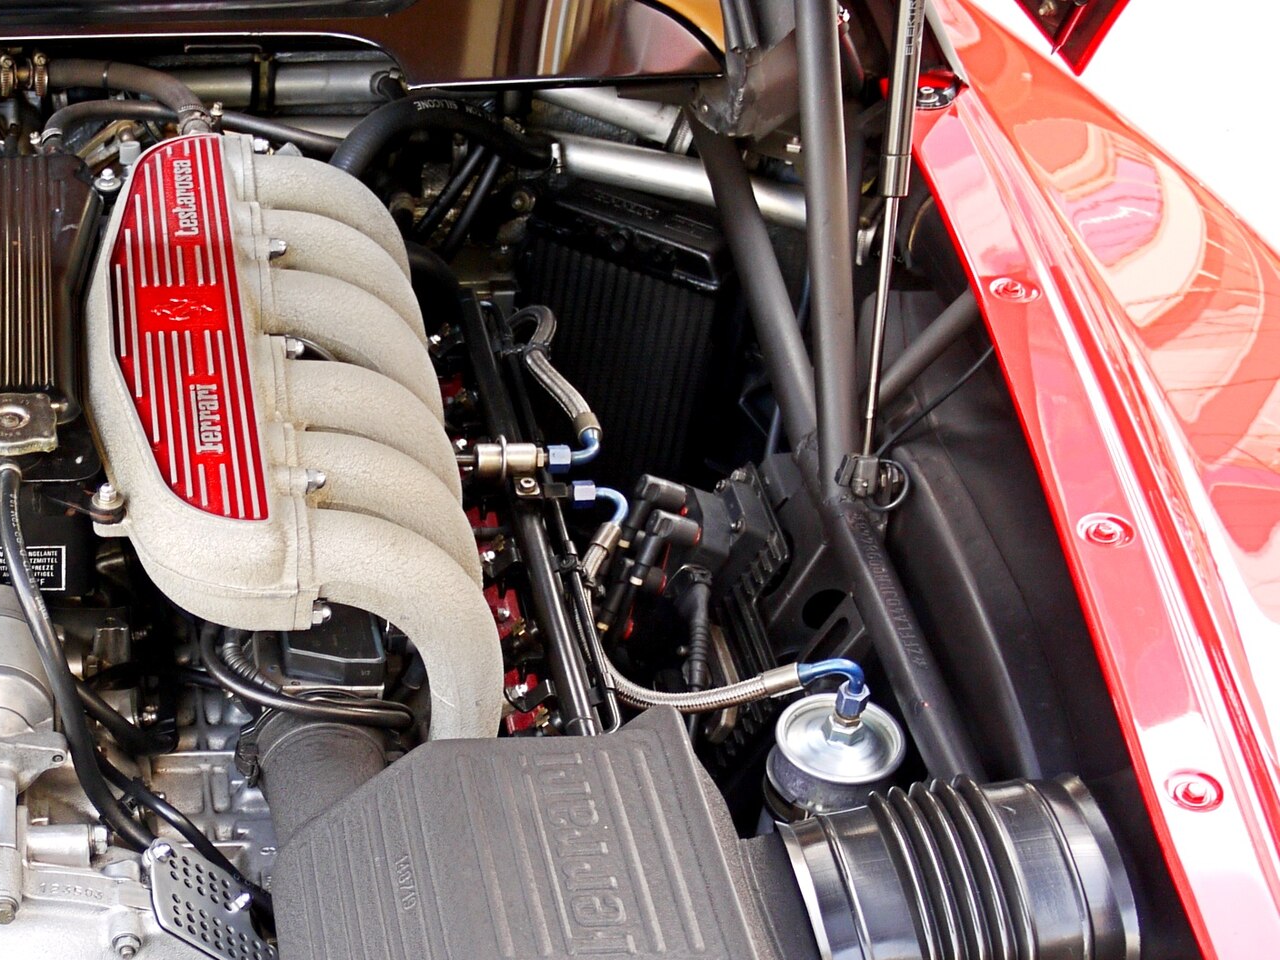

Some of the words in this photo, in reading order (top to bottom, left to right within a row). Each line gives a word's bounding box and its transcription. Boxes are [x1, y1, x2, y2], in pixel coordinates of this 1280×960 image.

[172, 160, 199, 236] testarossa
[189, 384, 224, 454] Ferrari
[522, 751, 637, 957] Ferrari
